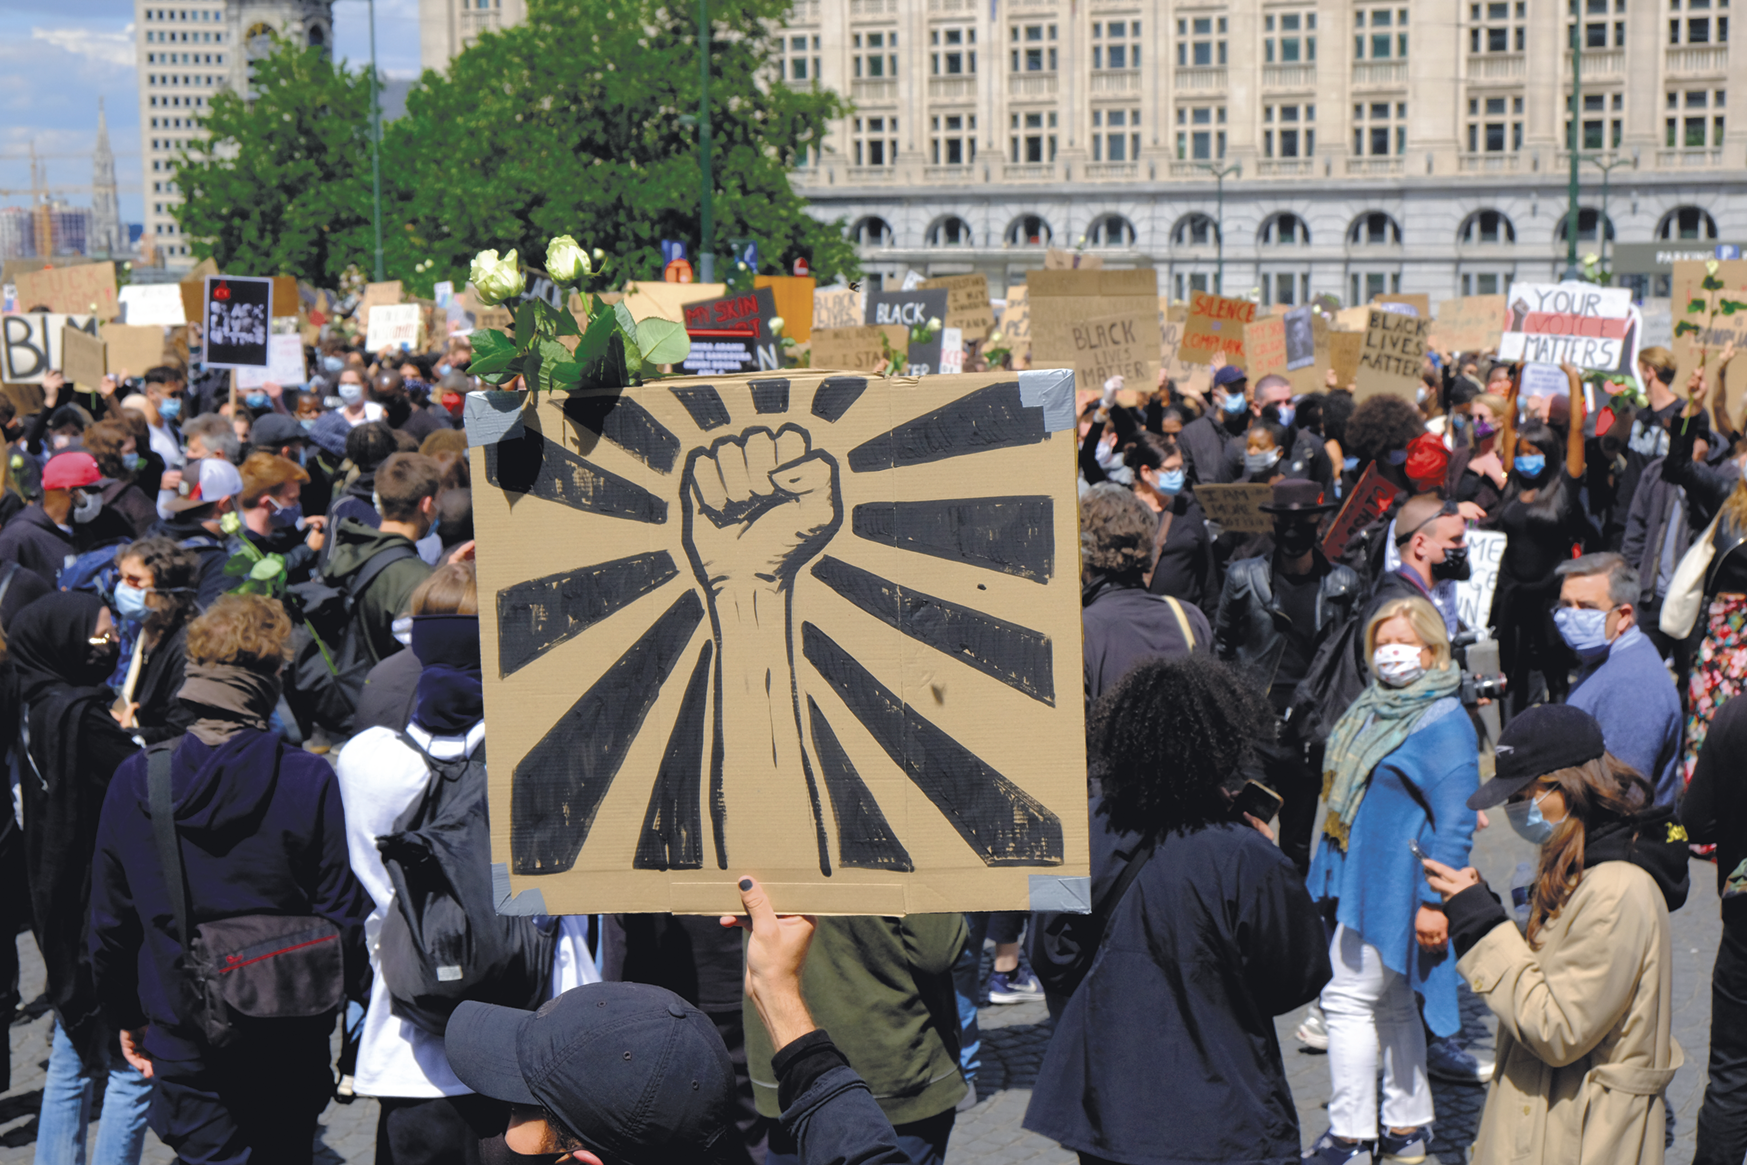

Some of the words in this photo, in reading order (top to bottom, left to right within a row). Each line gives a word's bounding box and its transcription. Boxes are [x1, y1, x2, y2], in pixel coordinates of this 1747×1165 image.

[29, 267, 100, 298] FUCK
[685, 306, 710, 326] MY
[714, 294, 759, 322] SKIN
[876, 303, 926, 324] BLACK
[1192, 294, 1256, 323] SILENCE
[1534, 288, 1602, 315] YOUR
[1072, 319, 1136, 350] BLACK
[1369, 311, 1428, 338] BLACK
[1532, 314, 1614, 338] VOICE
[1094, 347, 1132, 365] LIVES
[1366, 331, 1423, 357] LIVES
[1523, 335, 1614, 367] MATTERS
[855, 350, 882, 368] STA
[1359, 352, 1423, 379] MATTER
[1081, 361, 1145, 387] MATTER
[1223, 489, 1249, 501] AM
